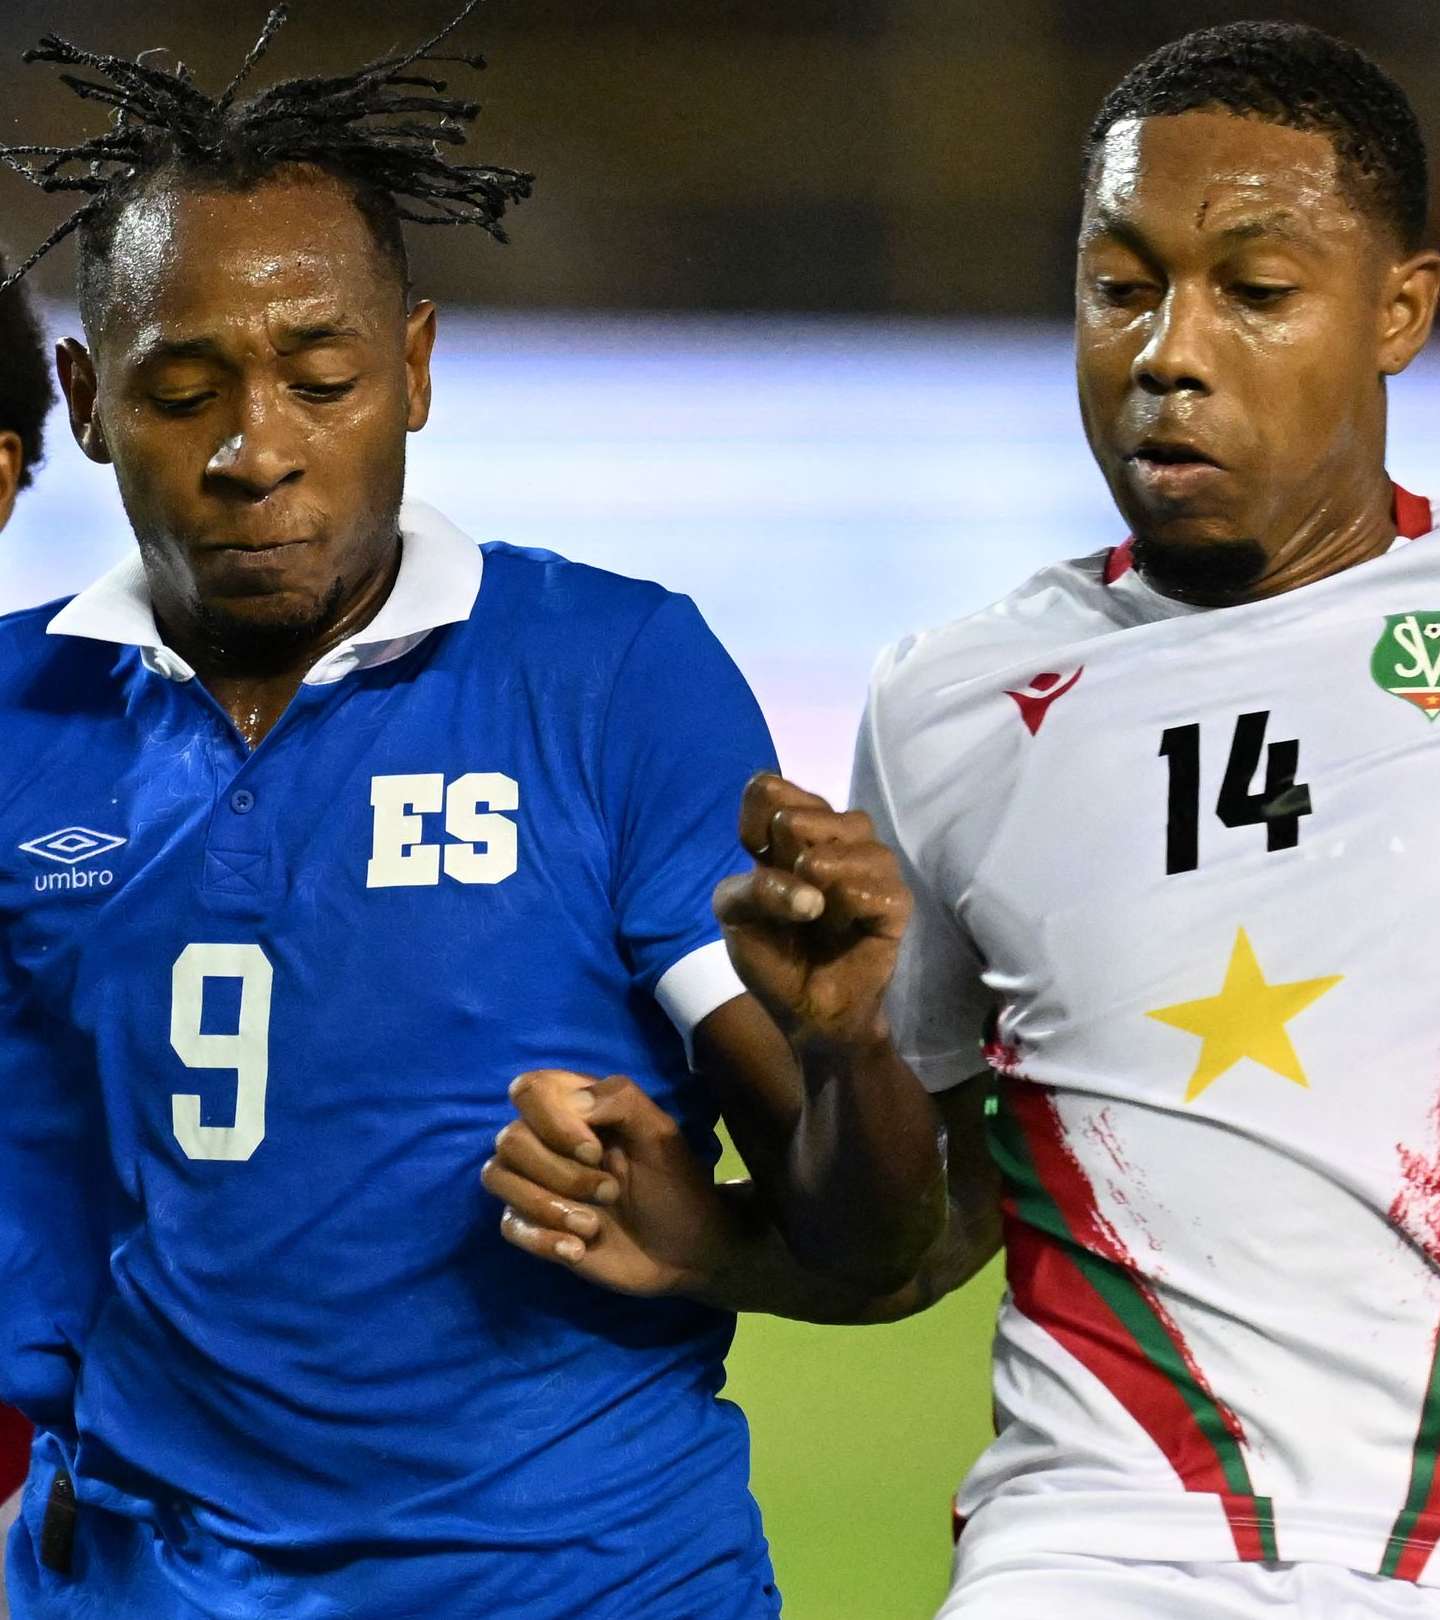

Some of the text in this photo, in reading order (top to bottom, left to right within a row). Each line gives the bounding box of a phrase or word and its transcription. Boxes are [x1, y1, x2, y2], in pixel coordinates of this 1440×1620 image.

[366, 772, 519, 888] ES
[1158, 710, 1312, 875] 14
[34, 866, 113, 891] umbro
[170, 943, 273, 1161] 9
